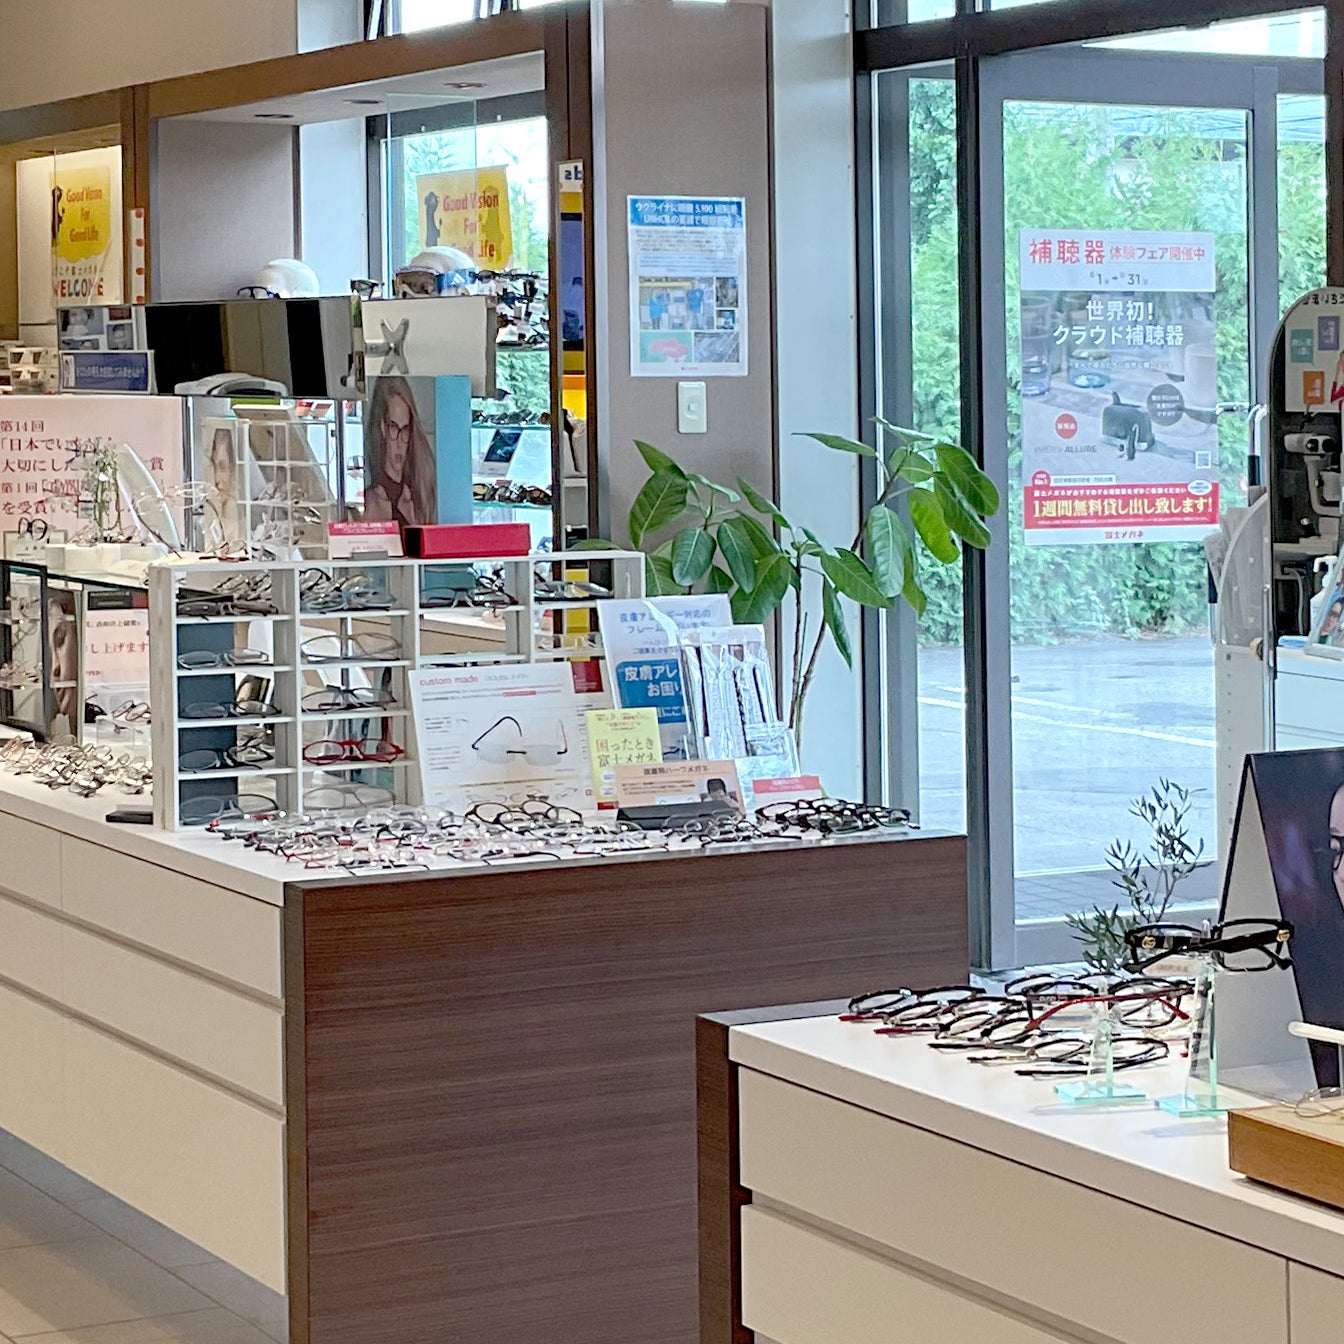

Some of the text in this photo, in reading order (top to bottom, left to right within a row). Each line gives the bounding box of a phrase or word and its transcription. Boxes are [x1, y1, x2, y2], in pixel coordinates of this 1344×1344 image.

[443, 194, 468, 212] Good
[1029, 238, 1205, 265] 補聴器 体験フェア開催中
[1053, 325, 1184, 346] クラウド補聴器
[0, 420, 45, 434] 第14回
[1064, 444, 1097, 454] ALLURE
[419, 677, 452, 687] custom
[456, 674, 479, 685] made
[596, 738, 655, 752] 困ったとき
[597, 752, 656, 768] 富士メガネ
